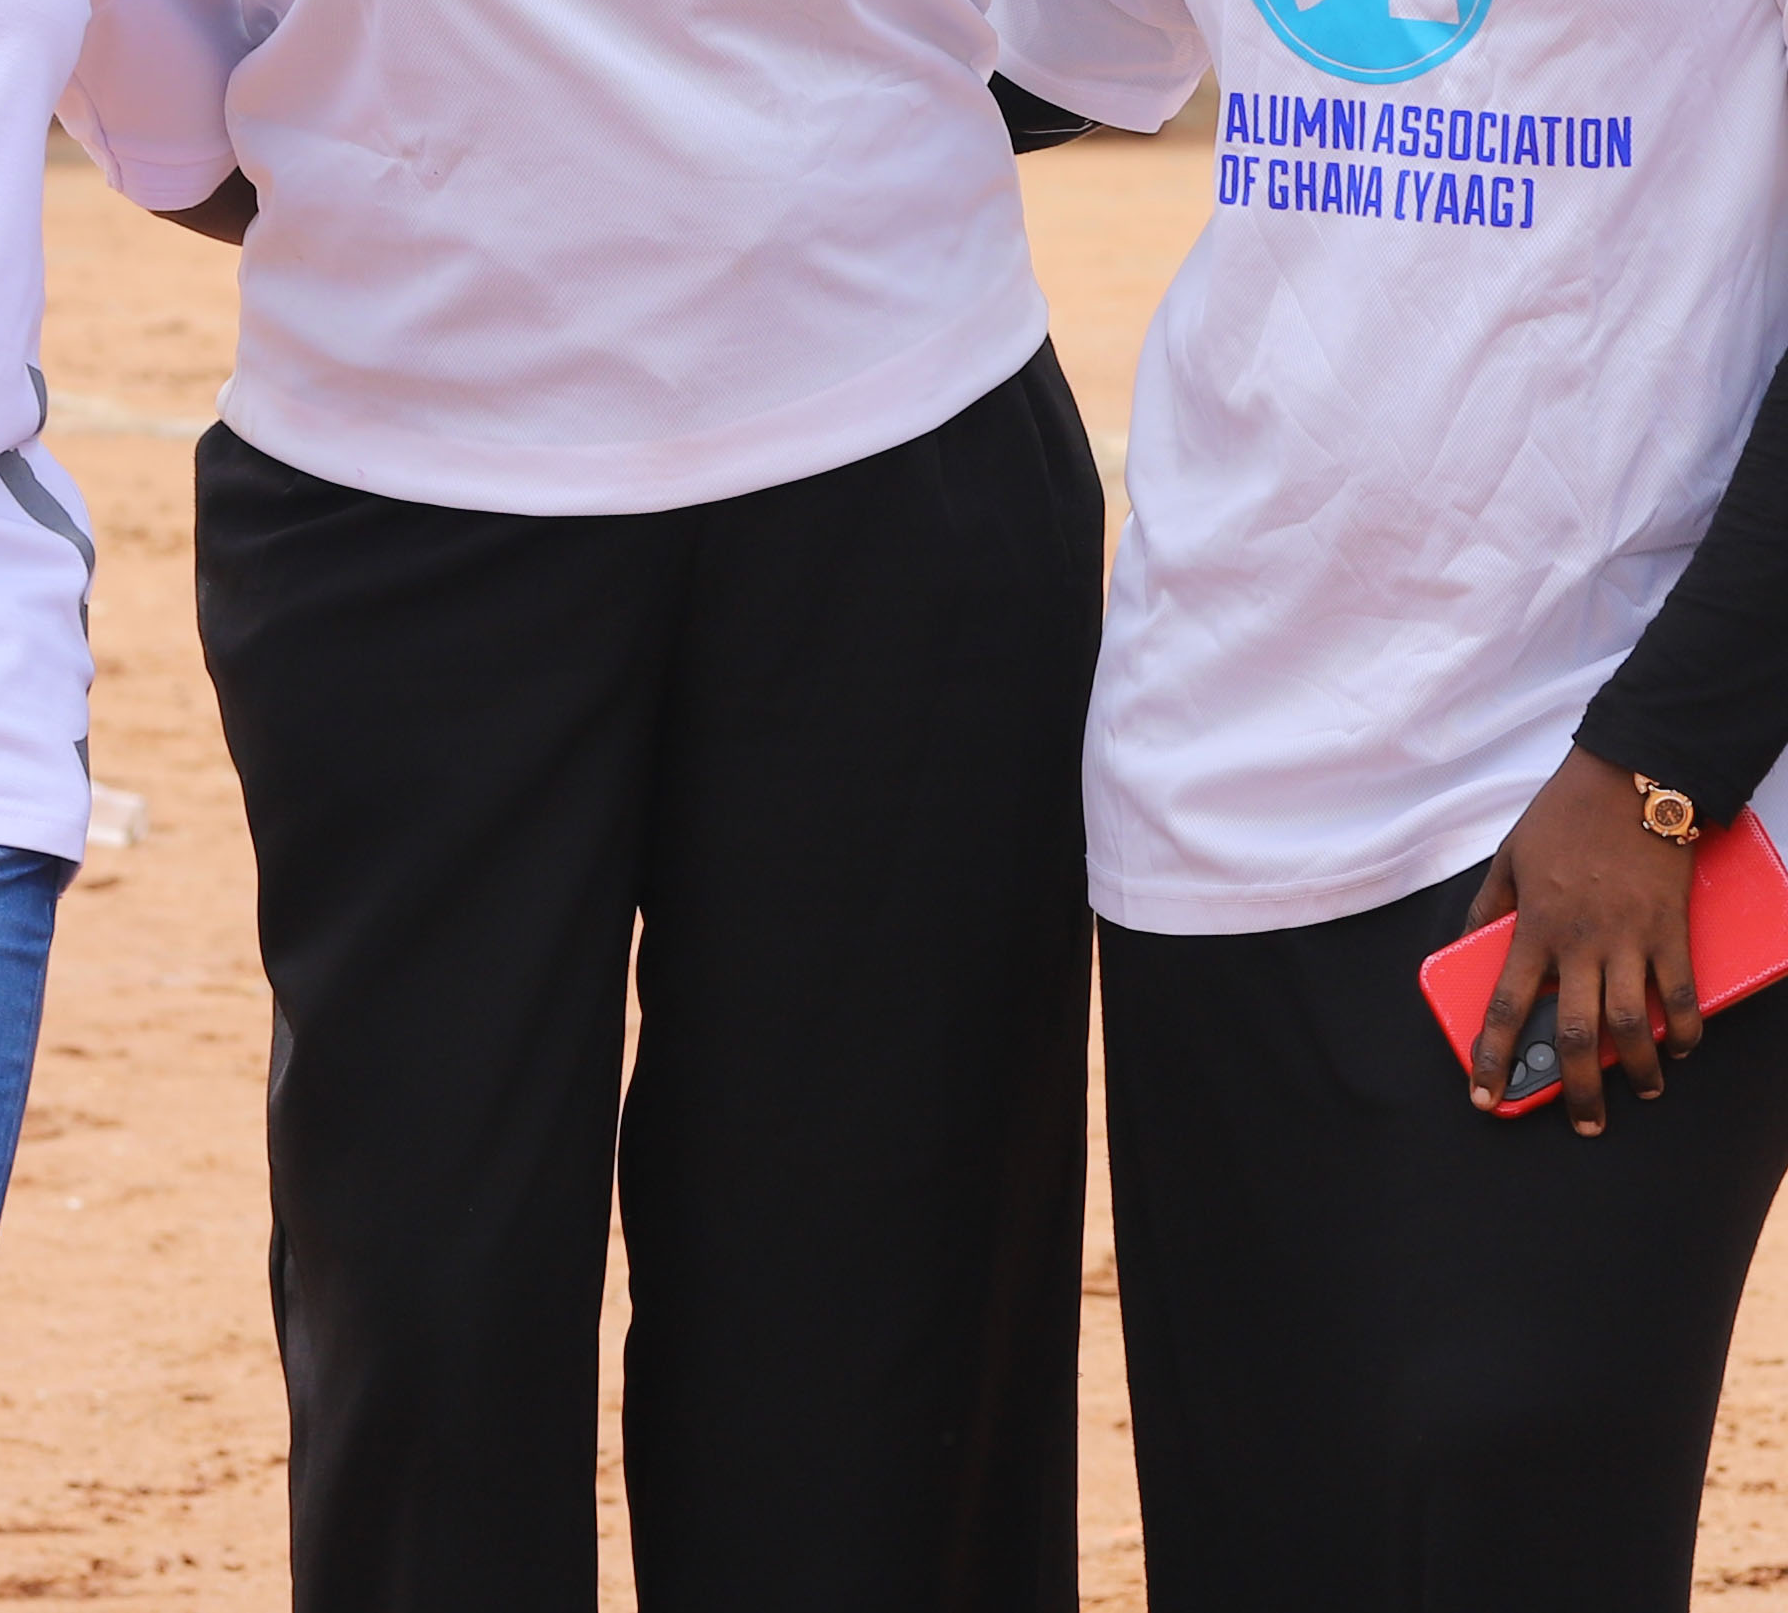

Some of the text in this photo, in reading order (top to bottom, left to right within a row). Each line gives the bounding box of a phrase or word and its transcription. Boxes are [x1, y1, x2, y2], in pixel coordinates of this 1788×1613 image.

[1224, 92, 1633, 169] ALUMNI ASSOCIATION
[1219, 154, 1261, 207] OF
[1268, 159, 1383, 218] GHANA
